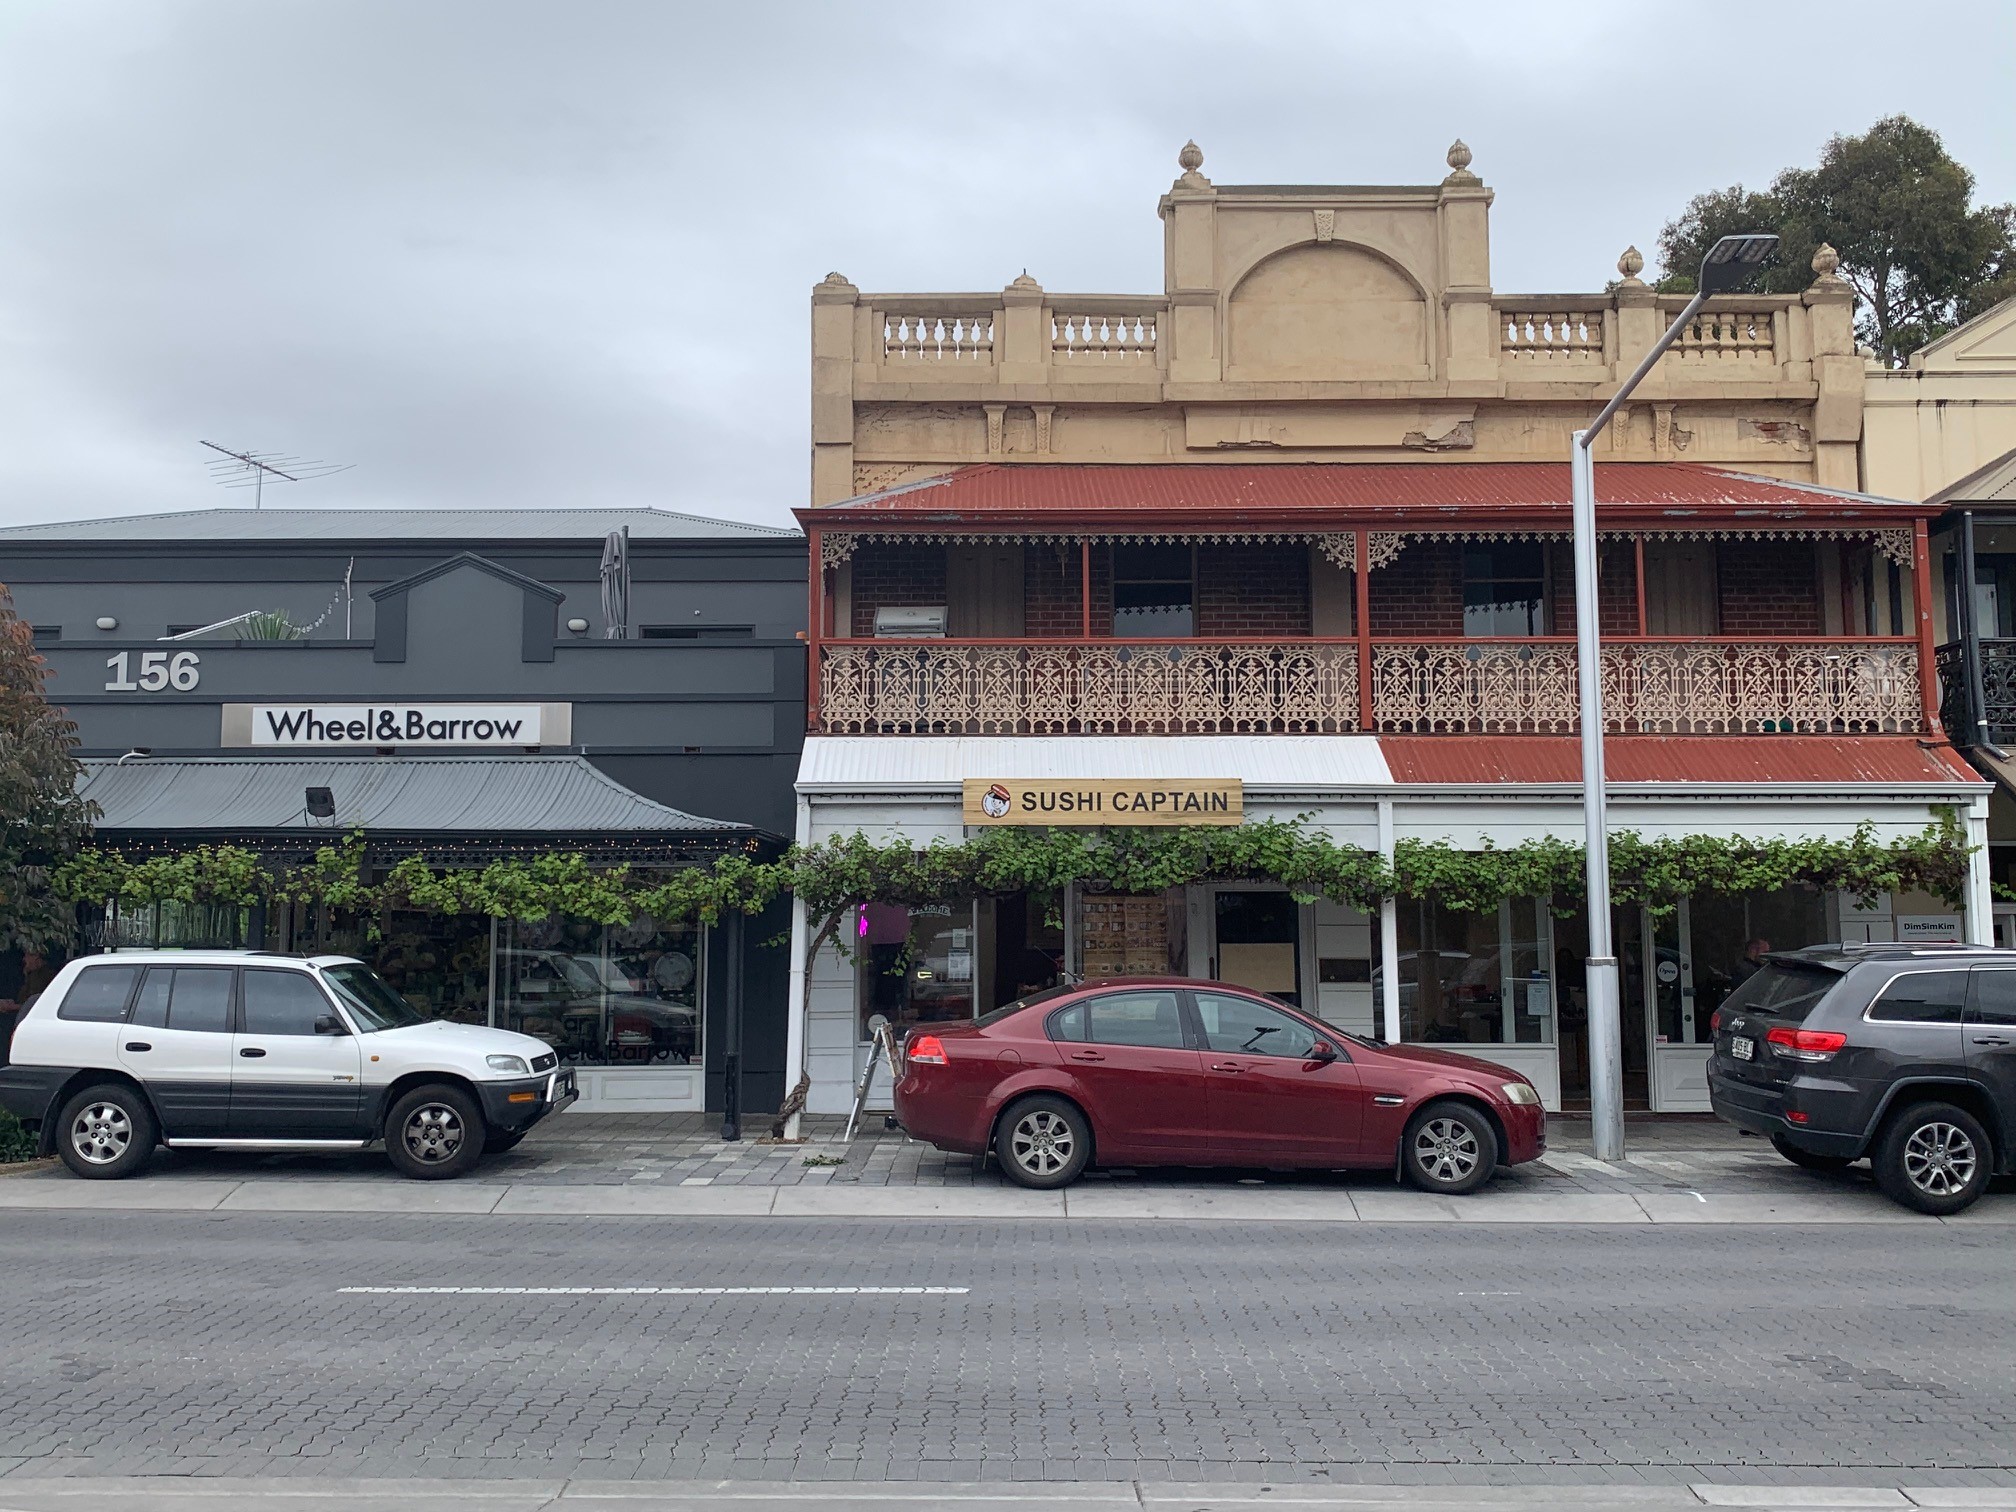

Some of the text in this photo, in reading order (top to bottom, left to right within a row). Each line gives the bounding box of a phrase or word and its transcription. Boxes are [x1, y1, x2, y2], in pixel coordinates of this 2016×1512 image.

[104, 651, 200, 692] 156
[265, 709, 523, 741] Wheel&Barrow
[1021, 791, 1102, 812] SUSHI
[1112, 791, 1229, 812] CAPTAIN
[1903, 922, 1955, 931] DimSimKim
